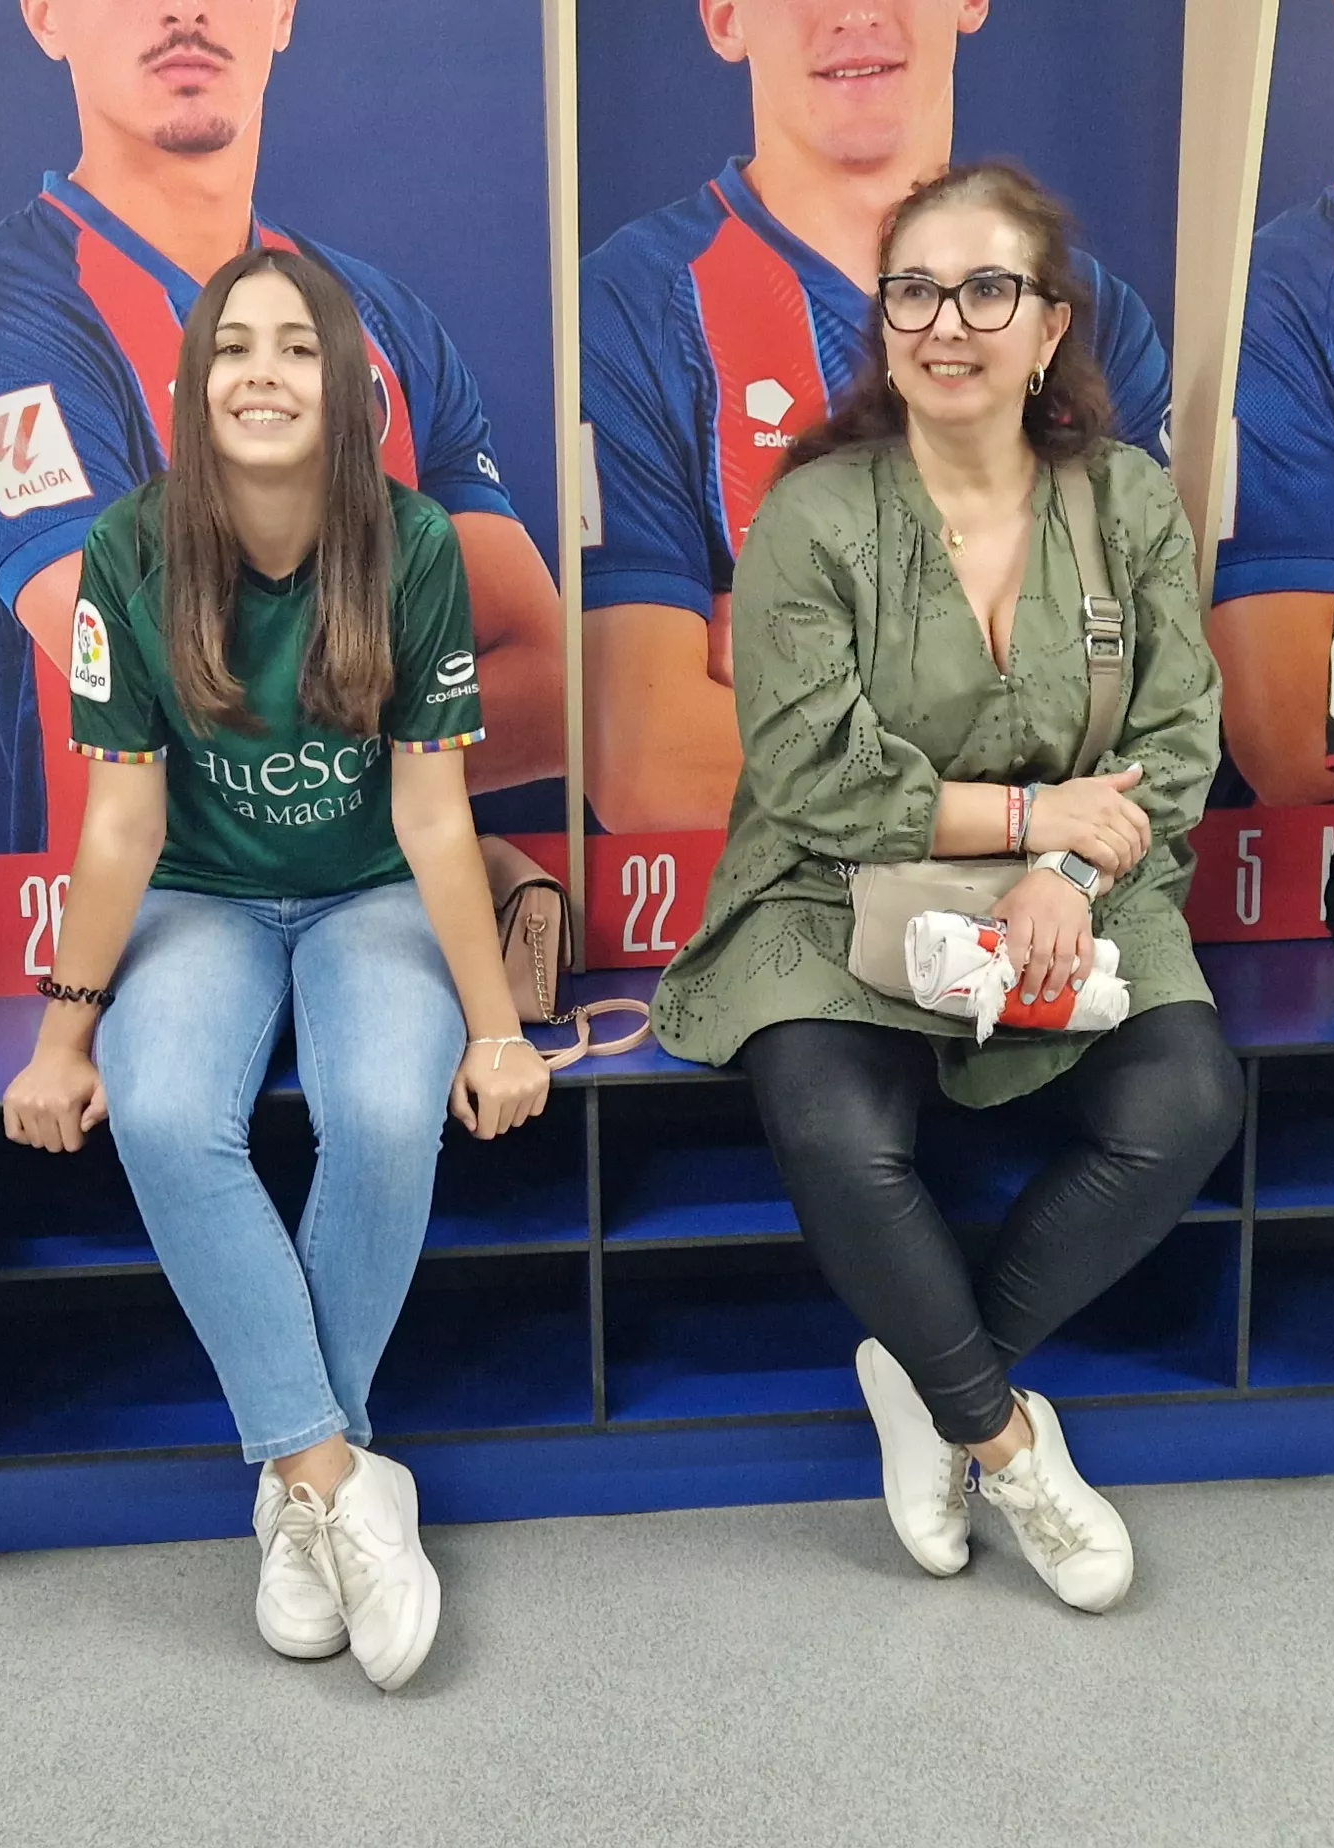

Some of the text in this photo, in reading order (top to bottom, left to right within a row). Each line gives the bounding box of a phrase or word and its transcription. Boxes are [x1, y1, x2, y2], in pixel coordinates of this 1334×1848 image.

[5, 468, 72, 500] LALIGA
[75, 664, 105, 688] Laiga
[622, 853, 676, 952] 22
[1237, 829, 1262, 925] 5
